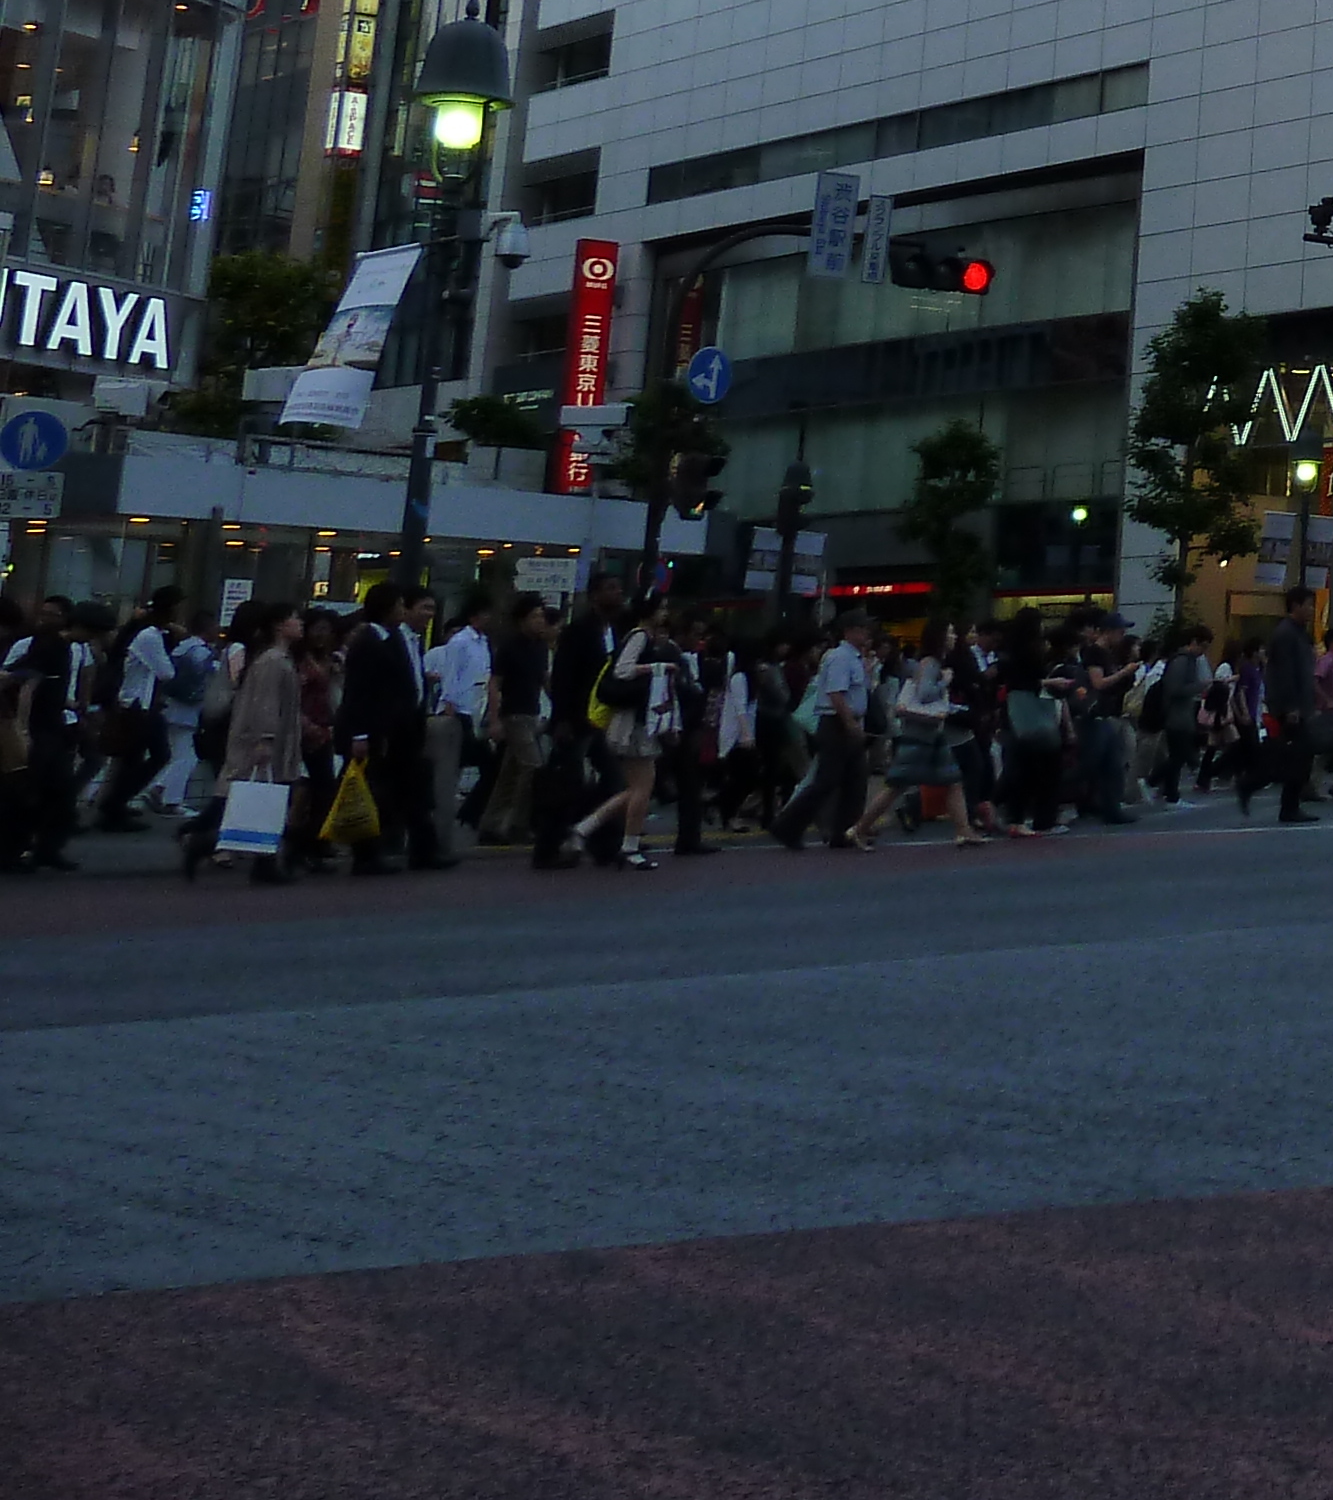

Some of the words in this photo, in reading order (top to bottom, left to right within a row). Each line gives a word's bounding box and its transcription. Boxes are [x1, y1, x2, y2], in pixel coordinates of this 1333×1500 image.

[0, 268, 169, 370] TAYA
[568, 314, 603, 482] 三菱東京U行
